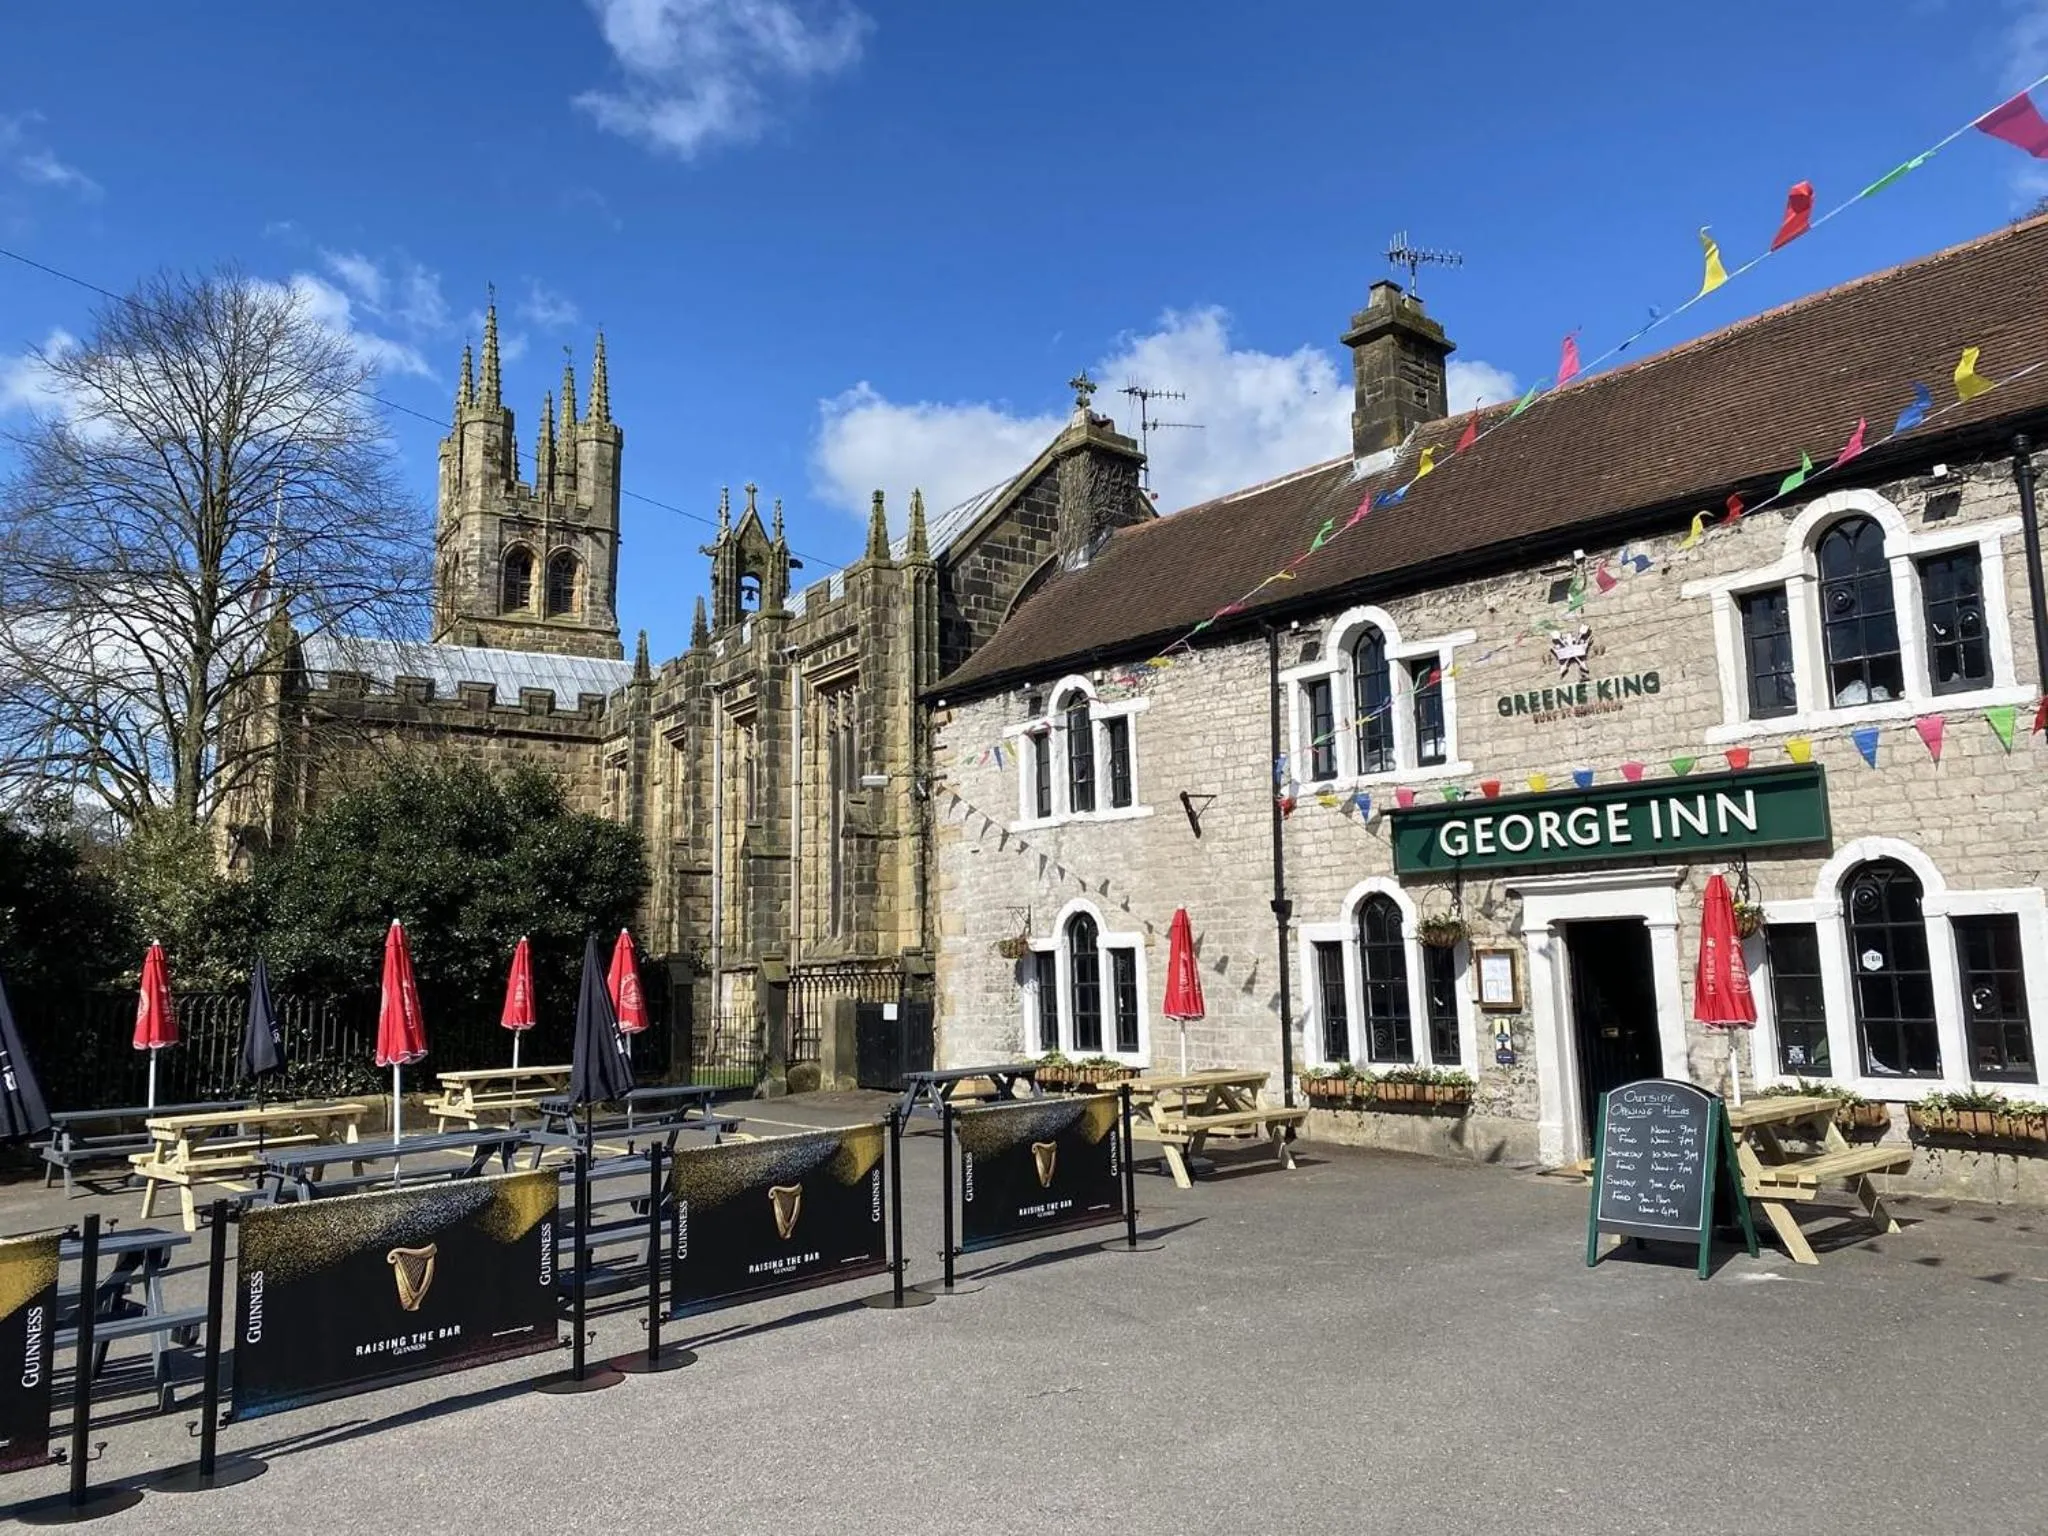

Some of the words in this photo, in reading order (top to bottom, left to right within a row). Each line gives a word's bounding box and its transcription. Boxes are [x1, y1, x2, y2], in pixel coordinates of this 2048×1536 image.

[1498, 682, 1588, 717] GREENE
[1597, 671, 1661, 701] KING
[1439, 803, 1633, 857] GEORGE
[1649, 789, 1758, 839] INN
[872, 1169, 880, 1222] GUINNESS
[965, 1151, 974, 1202] GUINNESS
[539, 1222, 551, 1286] GUINNESS
[677, 1200, 688, 1260] GUINNESS
[749, 1258, 784, 1274] RAISING
[786, 1255, 801, 1267] THE
[804, 1251, 820, 1263] BAR
[247, 1270, 264, 1344] GUINNESS
[21, 1305, 43, 1388] GUINNESS
[355, 1336, 407, 1356] RAISING
[412, 1331, 434, 1346] THE
[439, 1325, 461, 1338] BAR
[392, 1343, 427, 1356] GUINNESS
